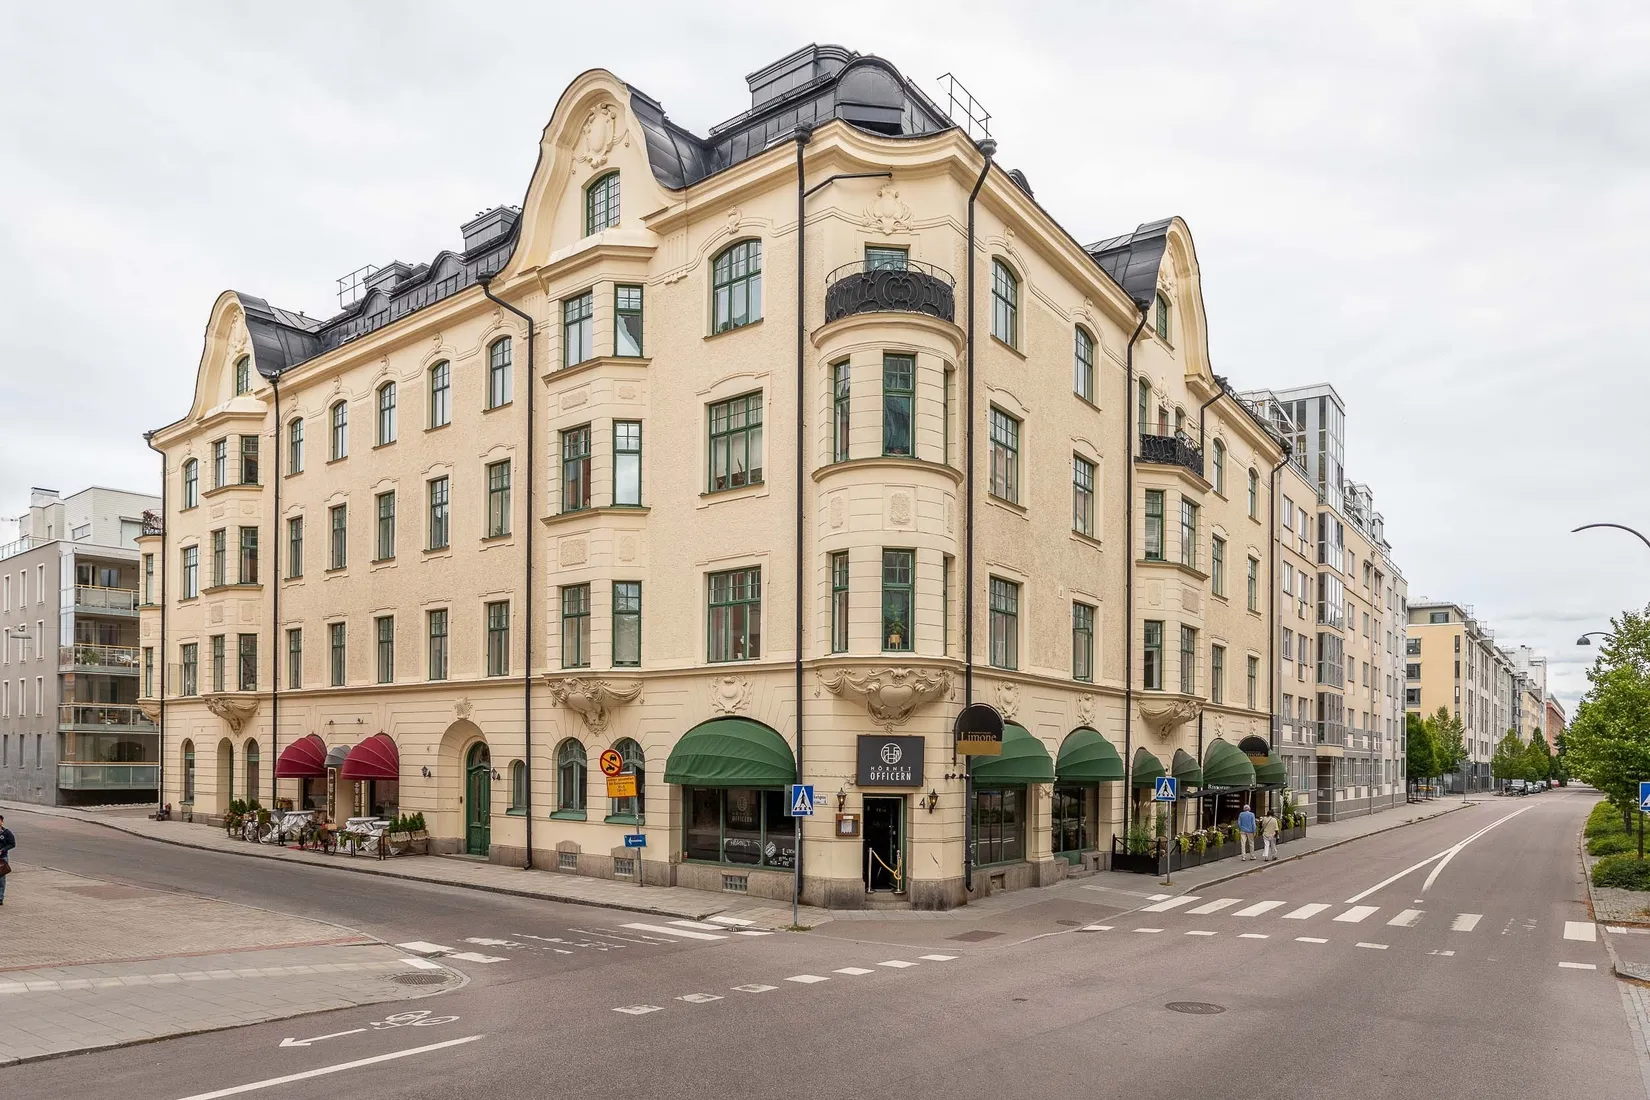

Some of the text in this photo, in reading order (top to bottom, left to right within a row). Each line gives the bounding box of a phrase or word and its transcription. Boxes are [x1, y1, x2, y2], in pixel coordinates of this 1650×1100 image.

[961, 731, 997, 742] Limone
[870, 772, 912, 781] OFFICERN
[919, 798, 926, 809] 4
